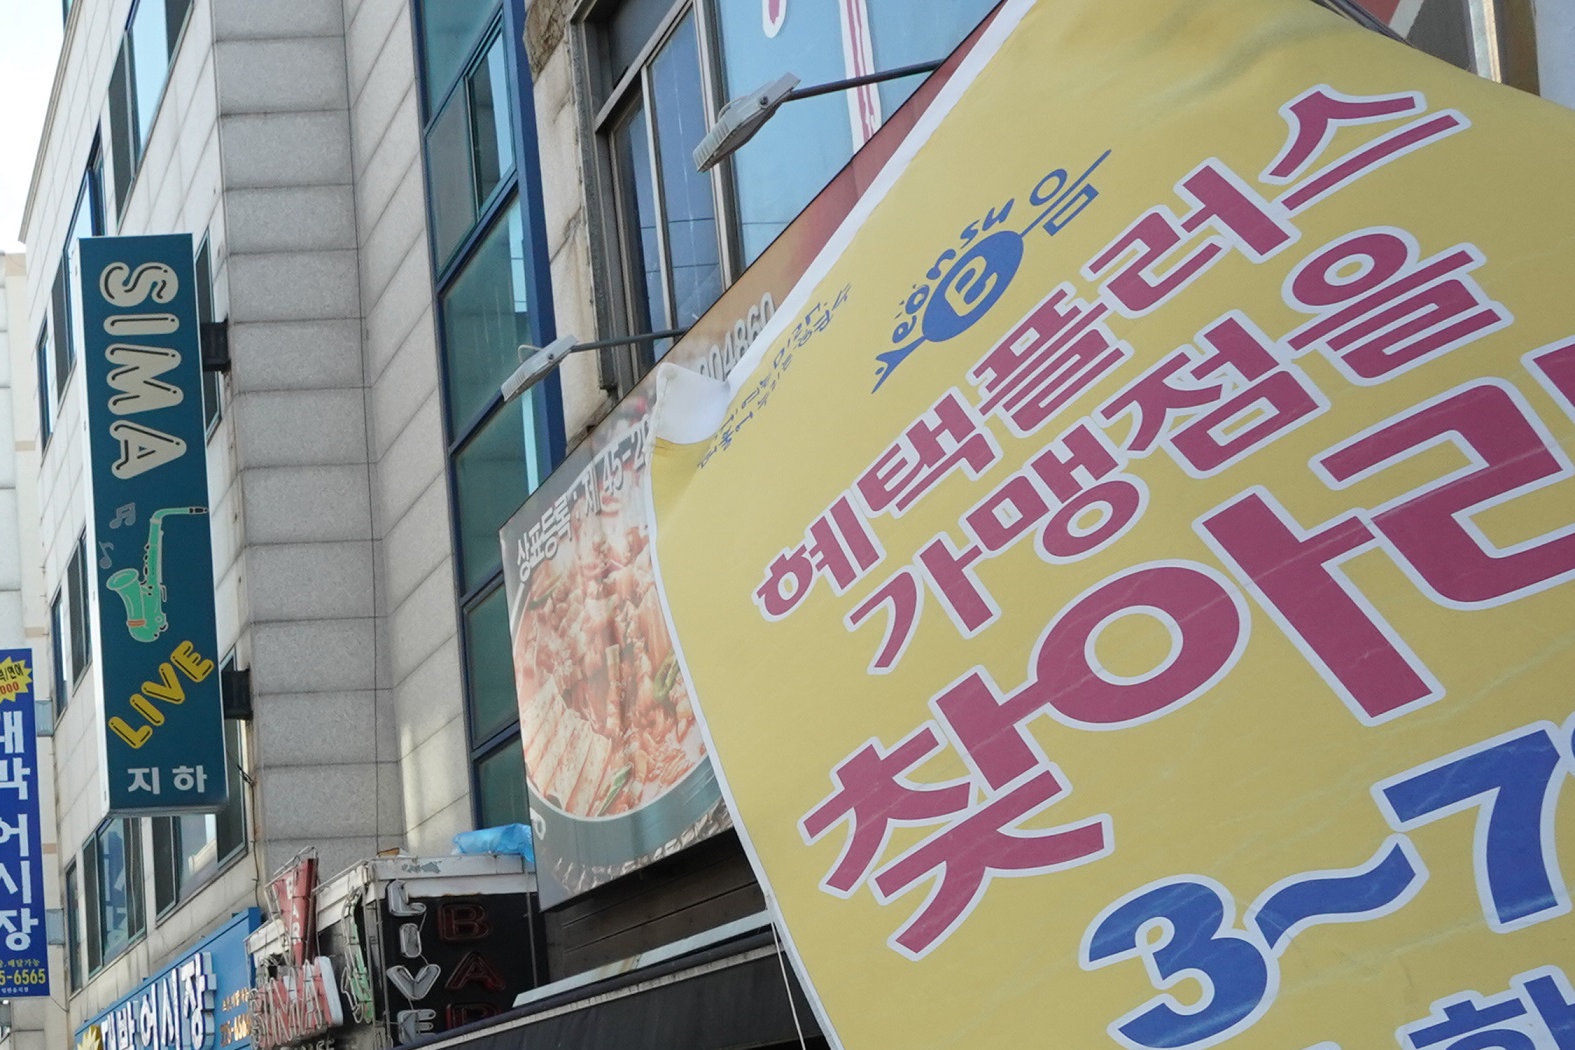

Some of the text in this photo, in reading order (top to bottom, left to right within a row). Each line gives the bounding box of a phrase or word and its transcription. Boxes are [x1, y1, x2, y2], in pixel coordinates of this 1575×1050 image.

[99, 261, 187, 480] SIMA
[756, 88, 1462, 616] 혜택플러스
[850, 234, 1500, 666] 가맹점을
[108, 639, 214, 749] LIVE
[128, 765, 207, 795] 지하
[387, 879, 441, 1044] LIVE
